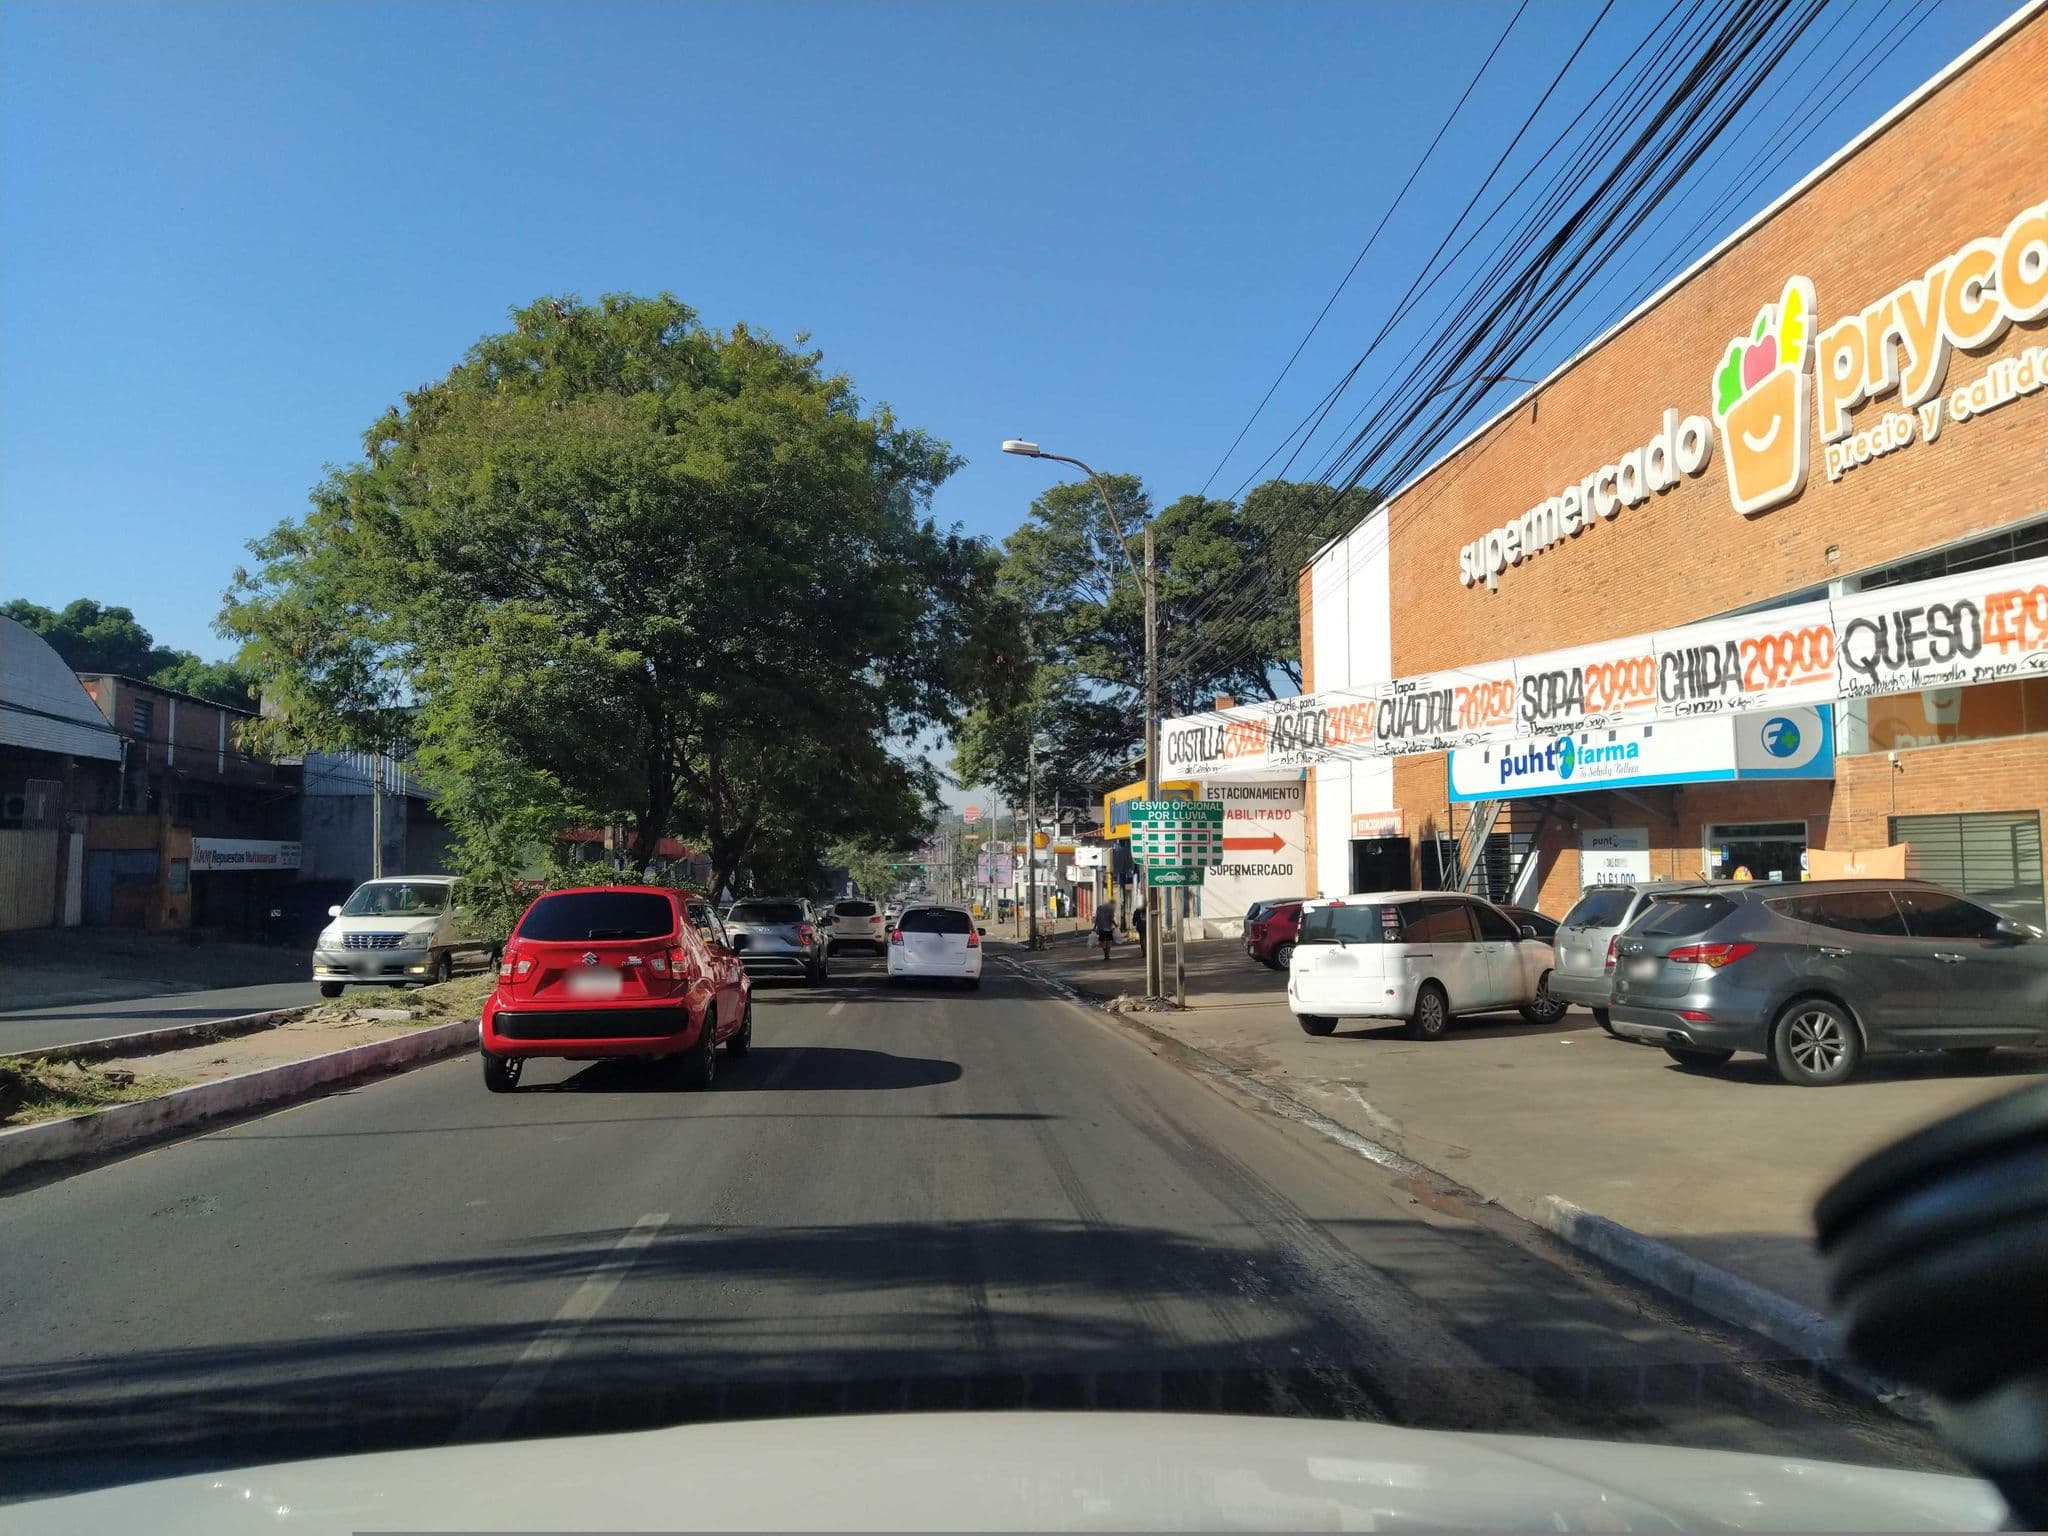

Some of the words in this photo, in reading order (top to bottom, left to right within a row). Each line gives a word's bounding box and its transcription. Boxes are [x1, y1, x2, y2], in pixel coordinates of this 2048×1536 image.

[1826, 412, 1916, 480] precio
[1918, 397, 1944, 442] y
[1459, 407, 1714, 589] supermercado
[1841, 598, 1982, 684] QUESO
[1391, 680, 1416, 694] Tapa
[1659, 639, 1744, 703] CHIPA
[1377, 688, 1457, 740] CUADRIL
[1521, 667, 1586, 722] SOPA
[1167, 724, 1226, 765] COSTILLA
[1270, 708, 1328, 754] ASADO
[1577, 742, 1639, 765] farma
[1131, 801, 1170, 811] DESVIO
[1172, 801, 1222, 811] OPCIONAL
[1207, 786, 1300, 800] ESTACIONAMIENTO
[1148, 811, 1170, 820] POR
[1172, 811, 1208, 820] LLUVIA
[1223, 808, 1292, 820] ABILITADO
[1210, 864, 1294, 876] SUPERMERCADO
